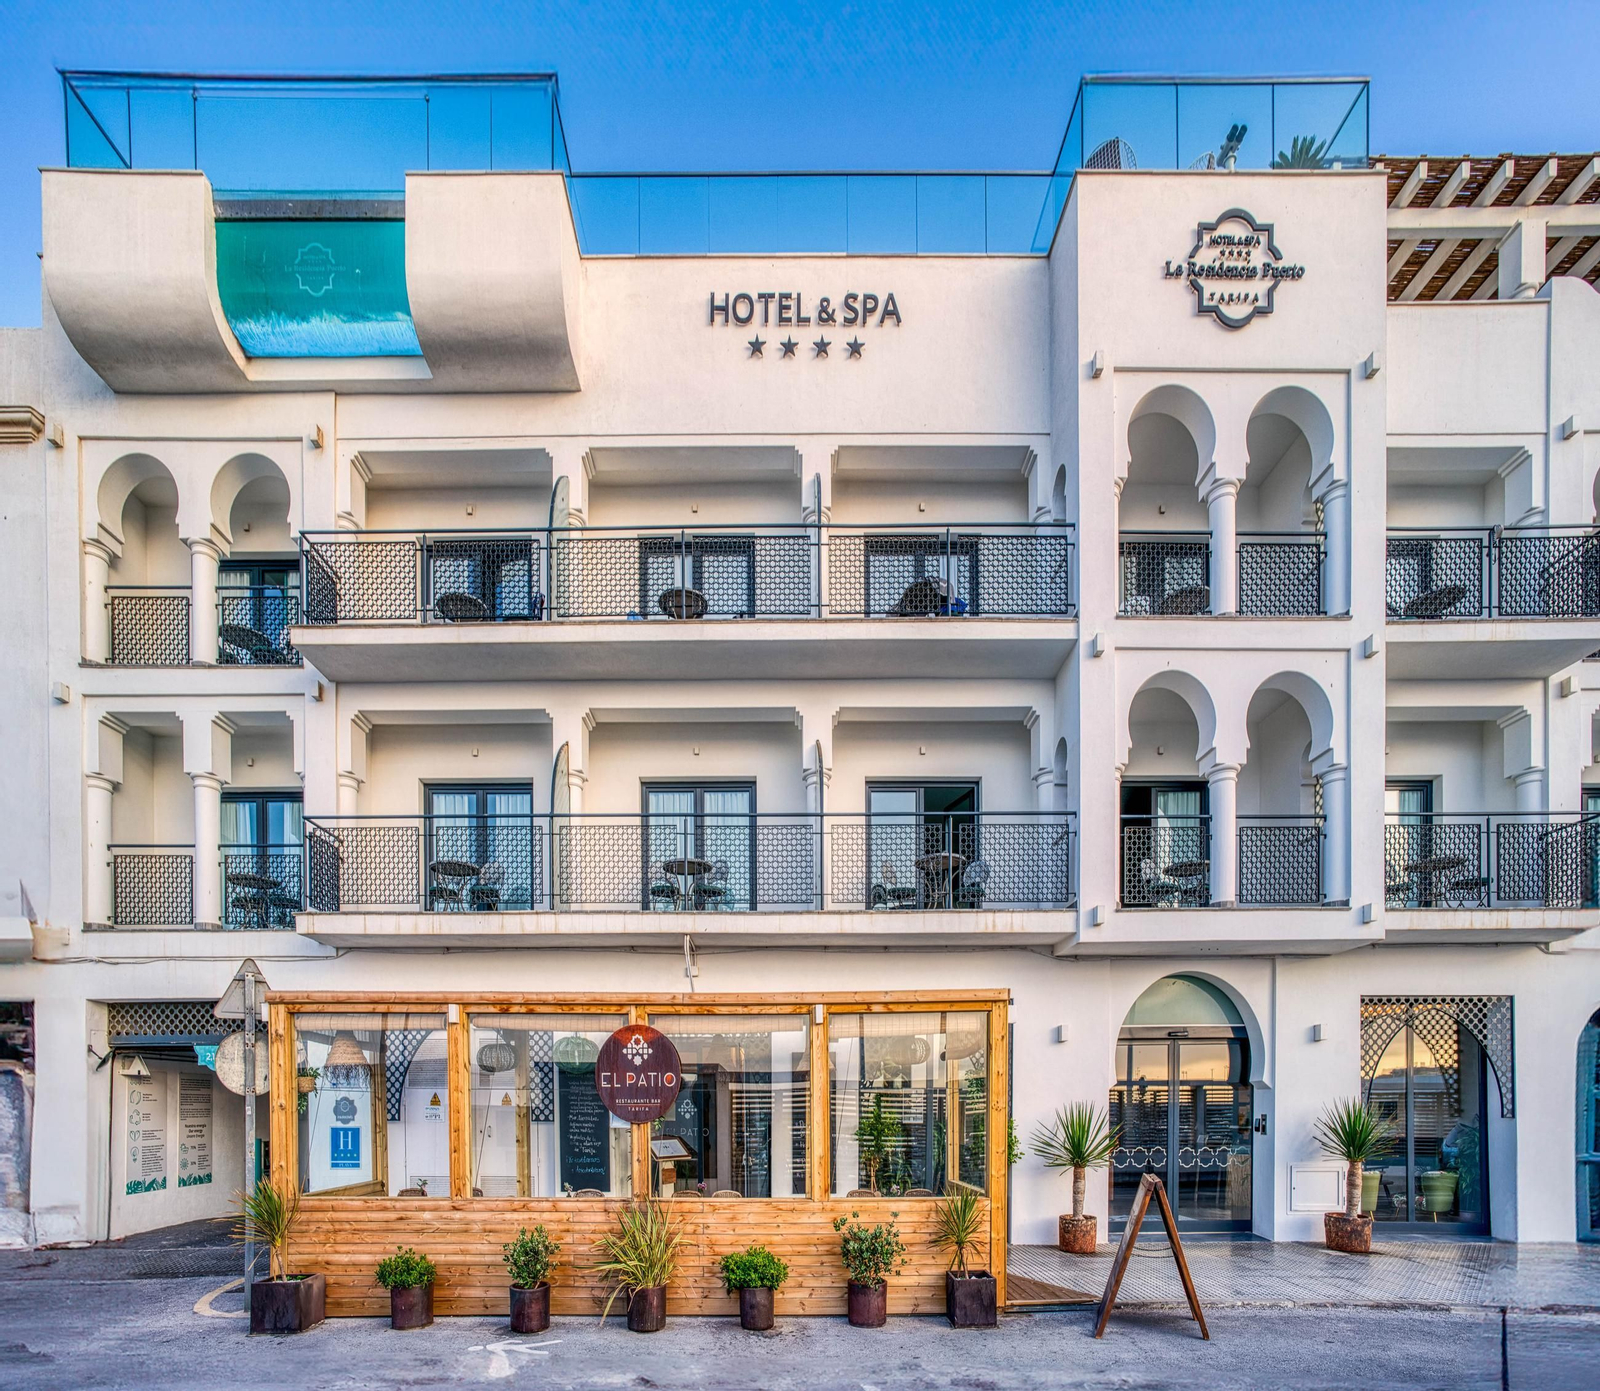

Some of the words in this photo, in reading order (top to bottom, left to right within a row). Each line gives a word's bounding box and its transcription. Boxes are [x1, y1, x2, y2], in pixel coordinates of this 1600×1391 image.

[1165, 260, 1184, 276] La
[1262, 262, 1306, 279] Puerto
[1209, 292, 1259, 304] TARIFA
[710, 292, 811, 324] HOTEL
[843, 292, 902, 324] SPA
[601, 1072, 621, 1087] EL
[626, 1072, 676, 1087] PATIO
[338, 1130, 353, 1150] H
